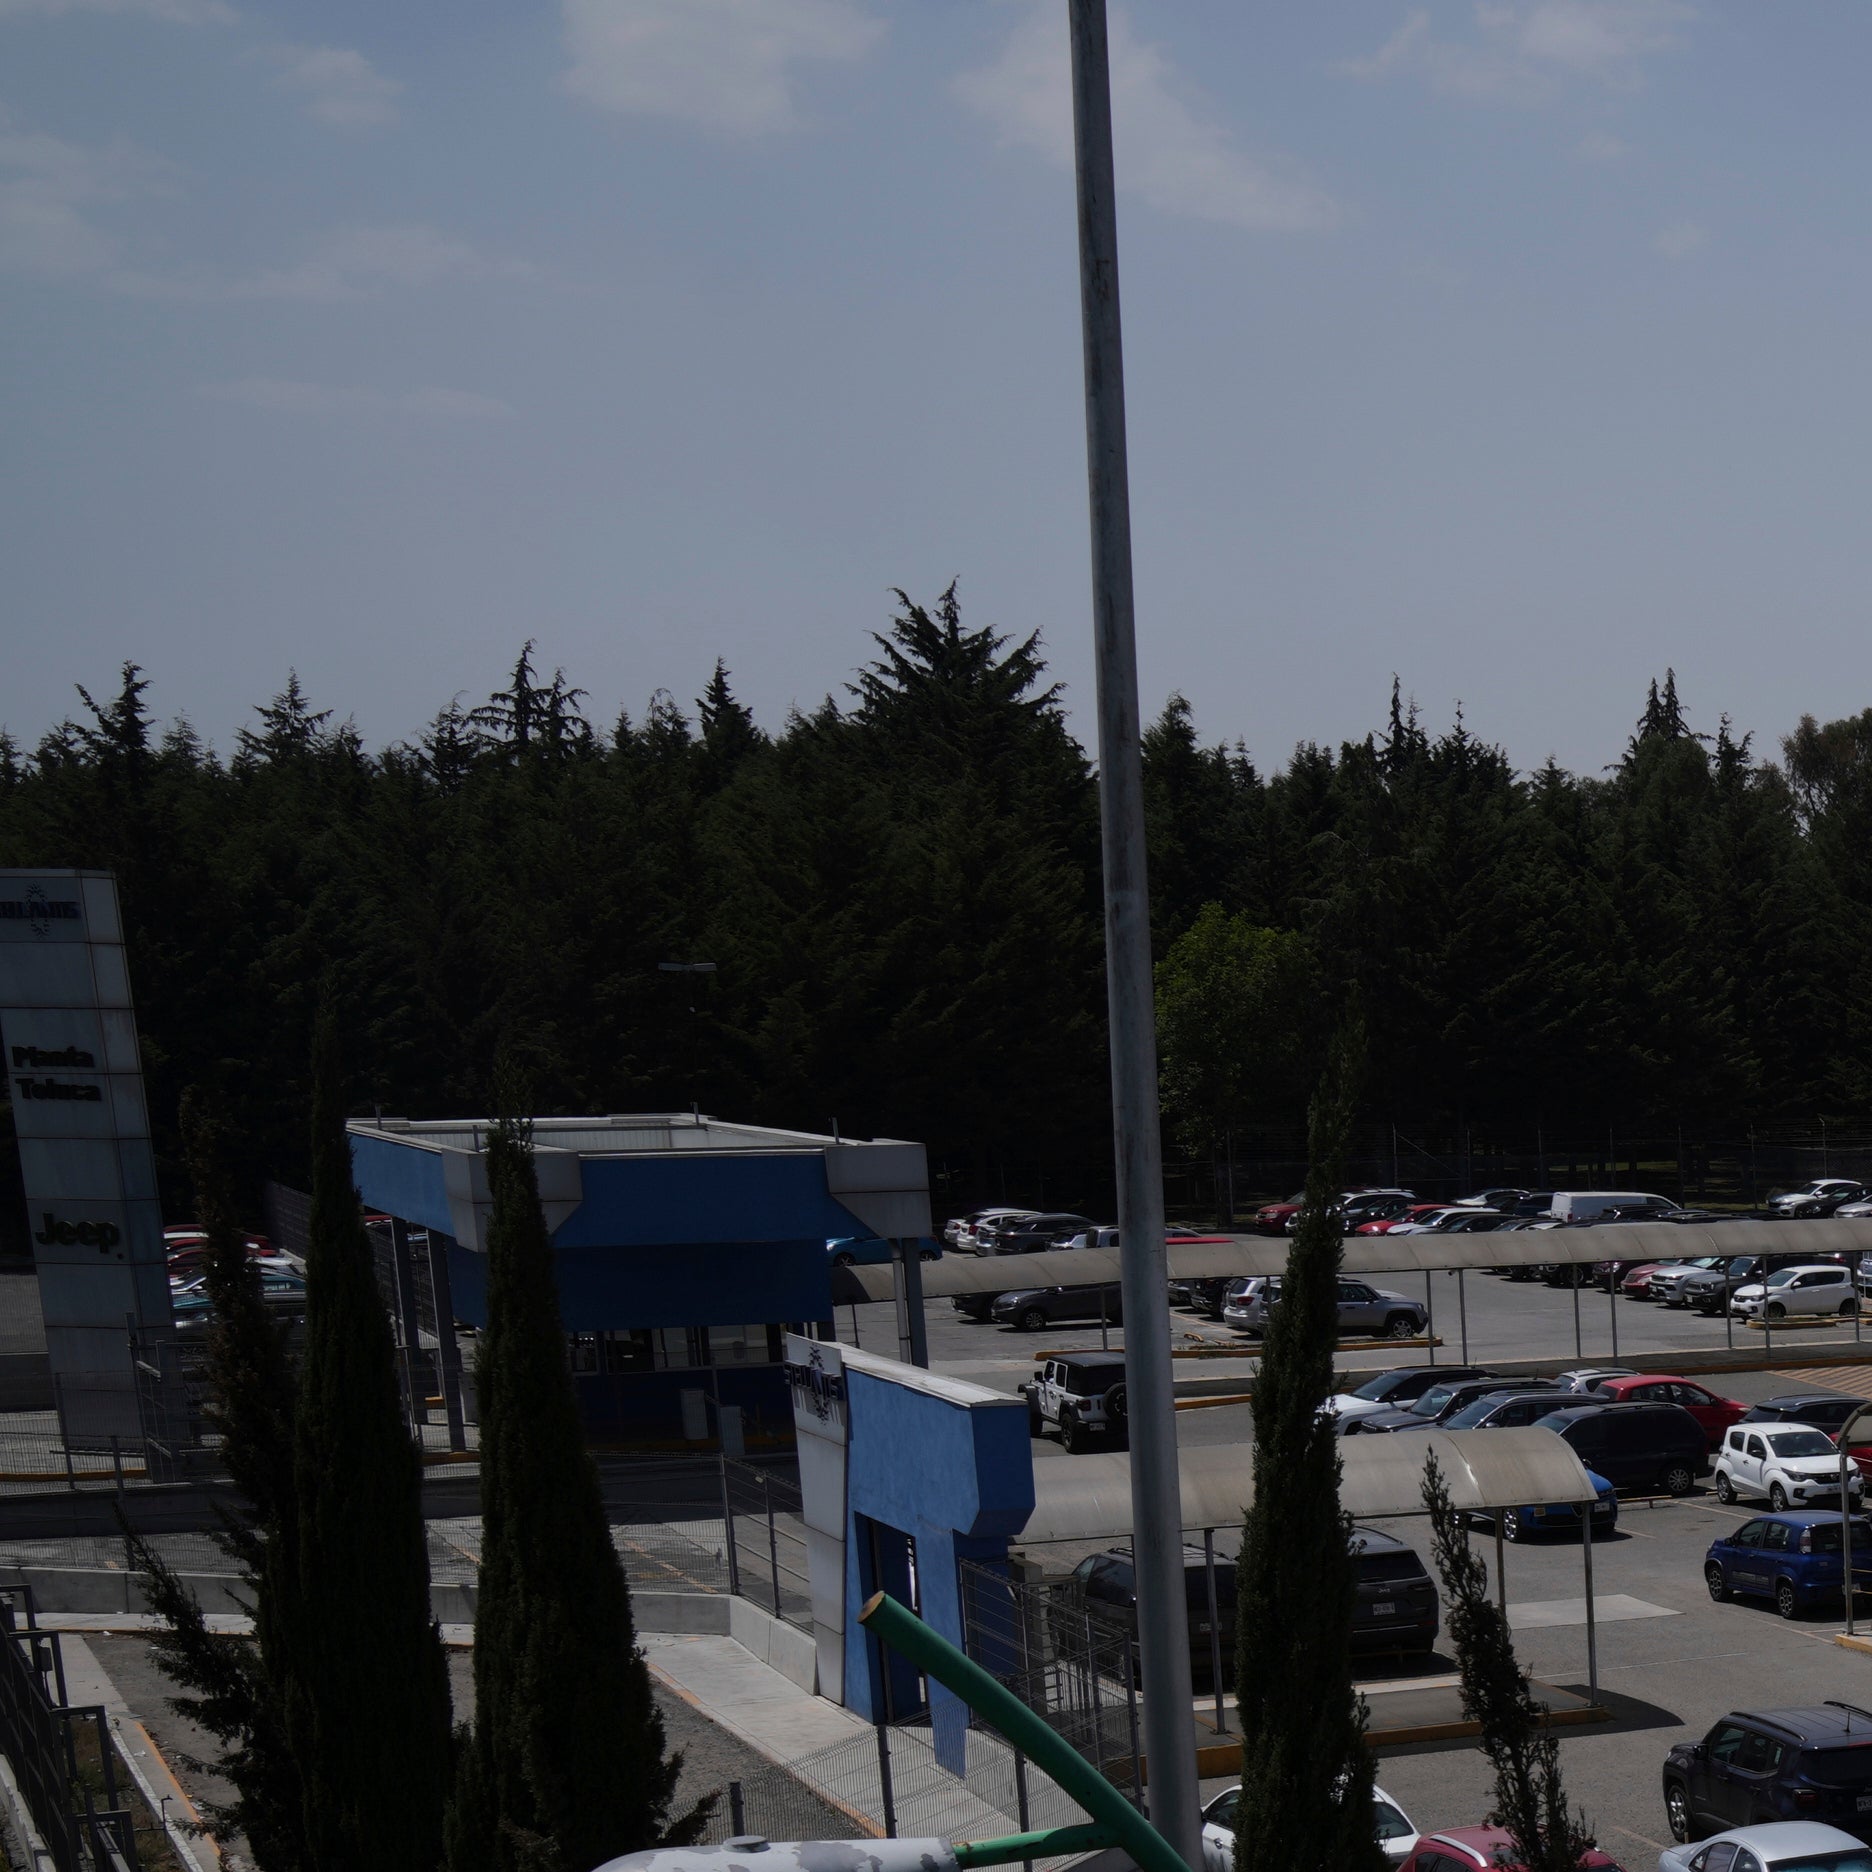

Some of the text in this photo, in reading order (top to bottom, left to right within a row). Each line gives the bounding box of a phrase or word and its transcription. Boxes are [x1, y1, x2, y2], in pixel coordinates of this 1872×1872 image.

[12, 1046, 94, 1068] Planta
[16, 1078, 102, 1101] Toluca
[37, 1212, 120, 1254] Jeep
